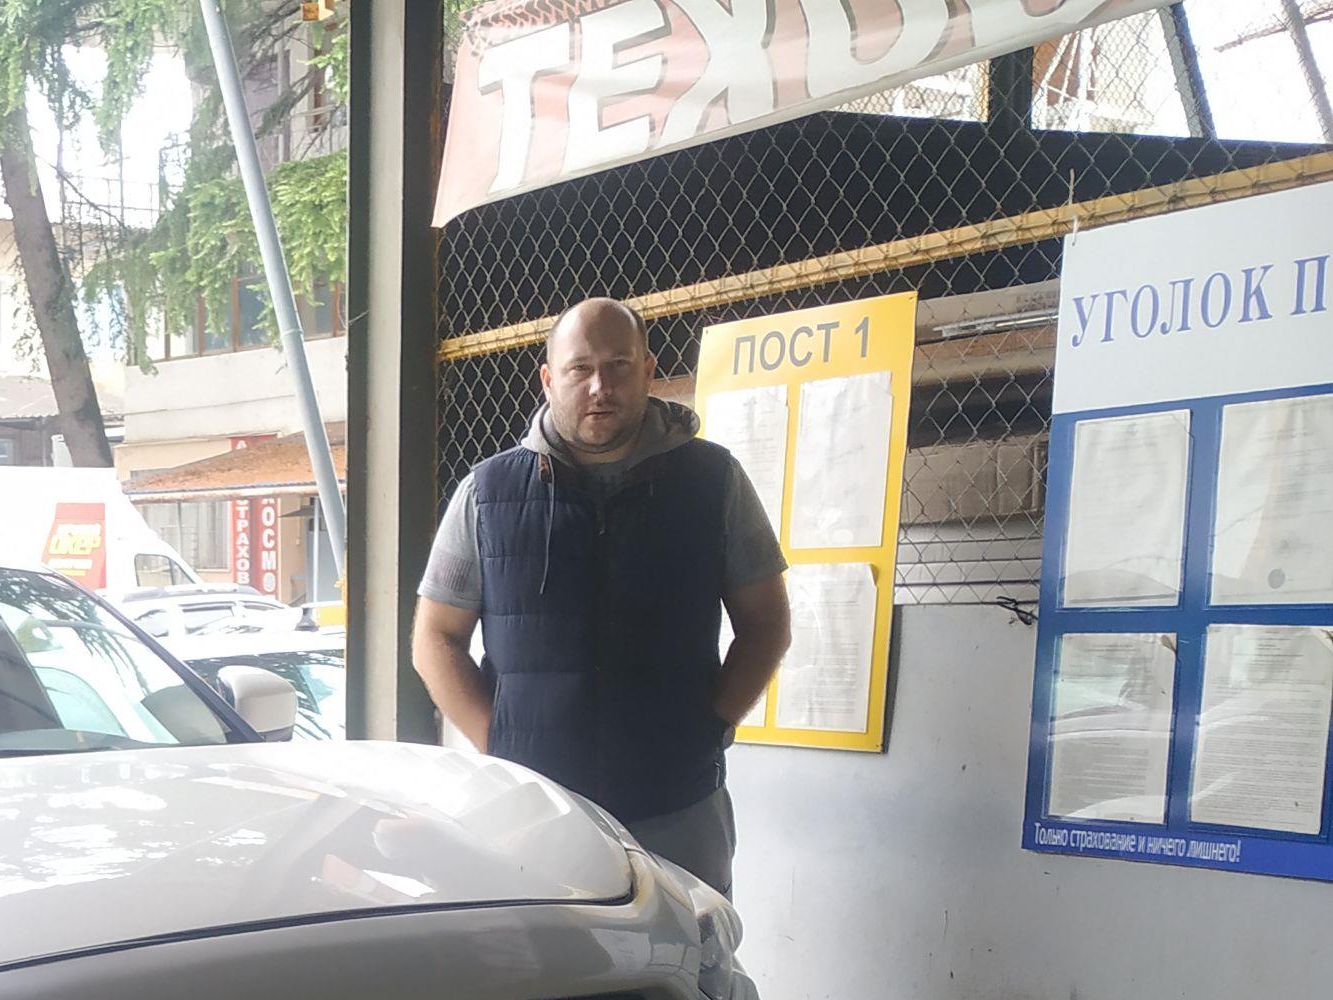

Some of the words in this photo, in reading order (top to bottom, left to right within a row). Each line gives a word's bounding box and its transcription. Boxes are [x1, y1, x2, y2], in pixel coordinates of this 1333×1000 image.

[1071, 264, 1274, 348] УГОЛОК
[733, 321, 840, 375] ПОСТ
[854, 316, 870, 358] 1
[1034, 822, 1068, 847] Только
[1069, 829, 1137, 852] страхование
[1137, 836, 1147, 852] и
[1147, 836, 1186, 858] ничего
[1186, 839, 1242, 863] лишнего!
